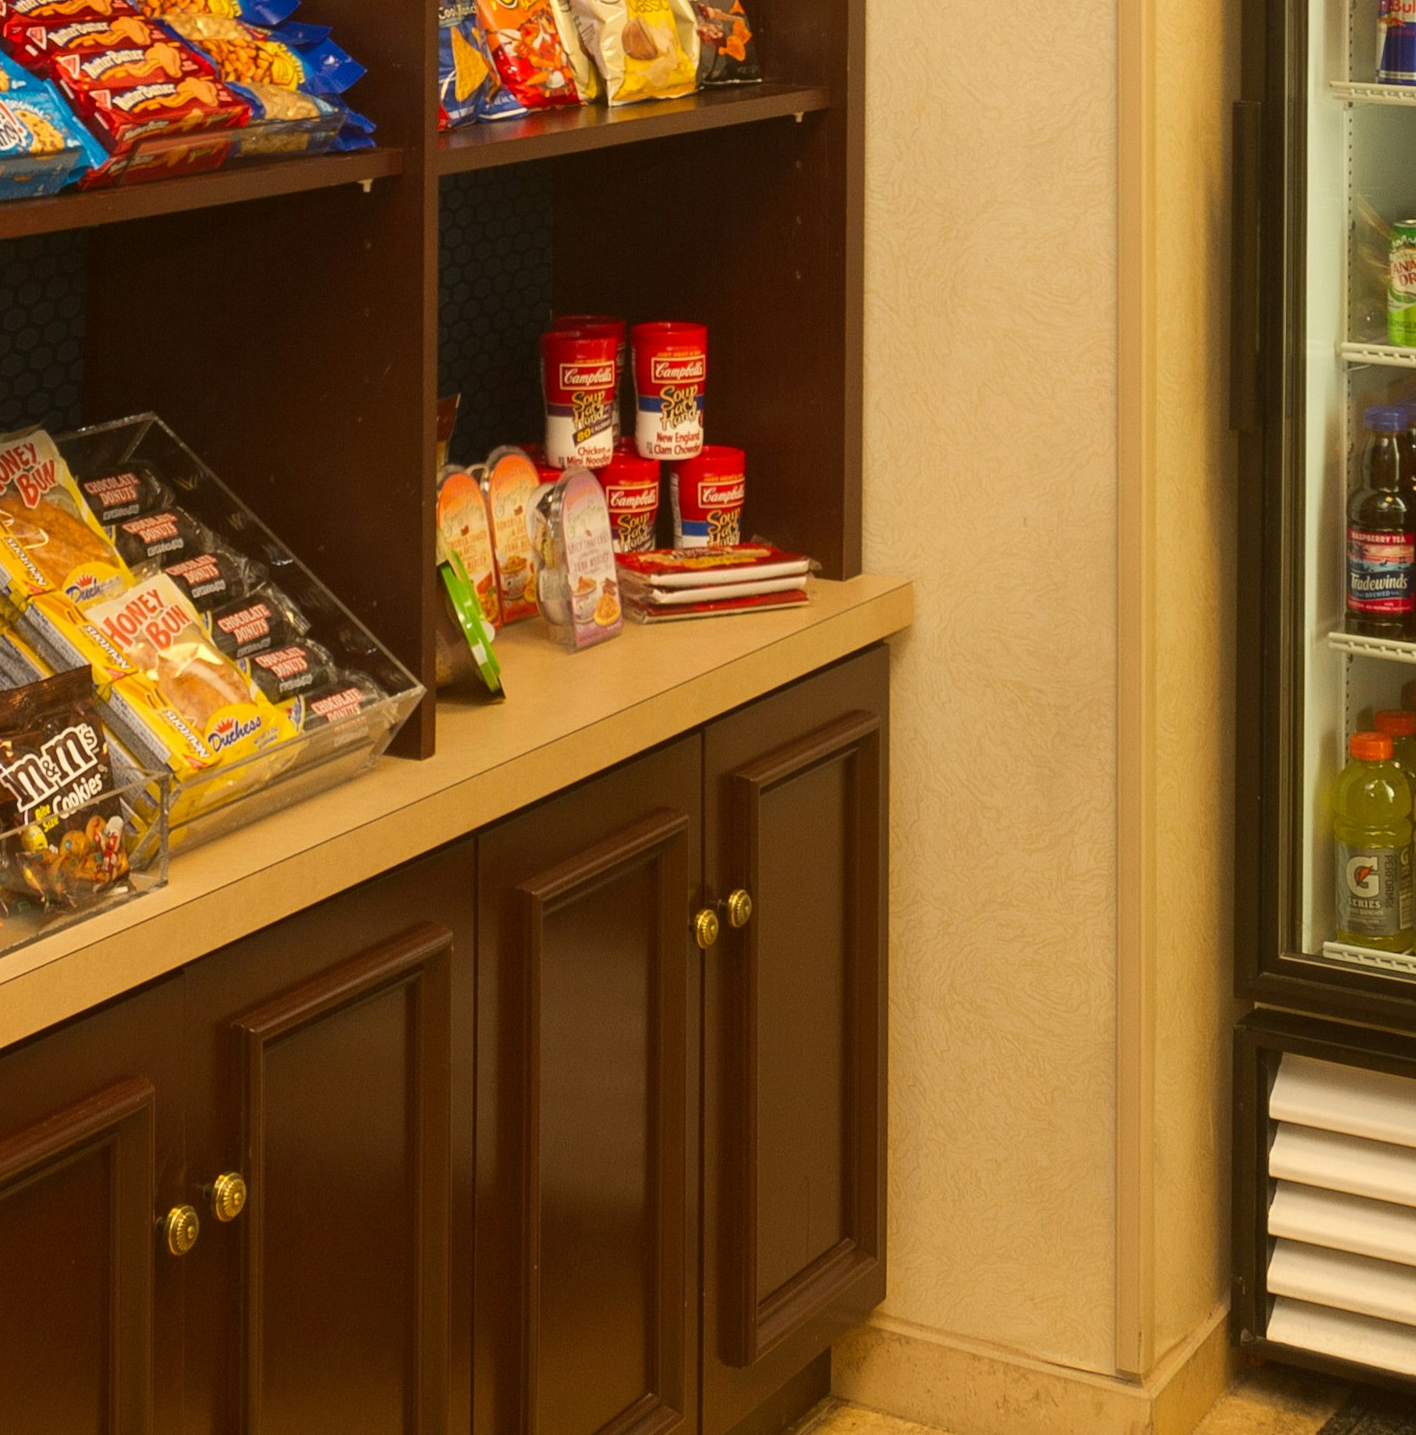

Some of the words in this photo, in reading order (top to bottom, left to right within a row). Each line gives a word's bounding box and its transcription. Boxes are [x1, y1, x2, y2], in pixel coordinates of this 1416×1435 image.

[660, 385, 699, 410] Soup
[654, 445, 672, 455] Clam
[656, 432, 672, 442] New
[674, 432, 700, 444] England
[16, 459, 56, 509] BUN
[84, 473, 141, 497] CHOCOLATE
[99, 488, 139, 507] DONUTS
[1350, 572, 1408, 591] Tradewinds
[104, 589, 167, 650] HONEY
[144, 604, 187, 650] BUN
[208, 714, 262, 754] Duchess
[52, 772, 103, 819] Cookies
[1346, 897, 1382, 910] SERIES
